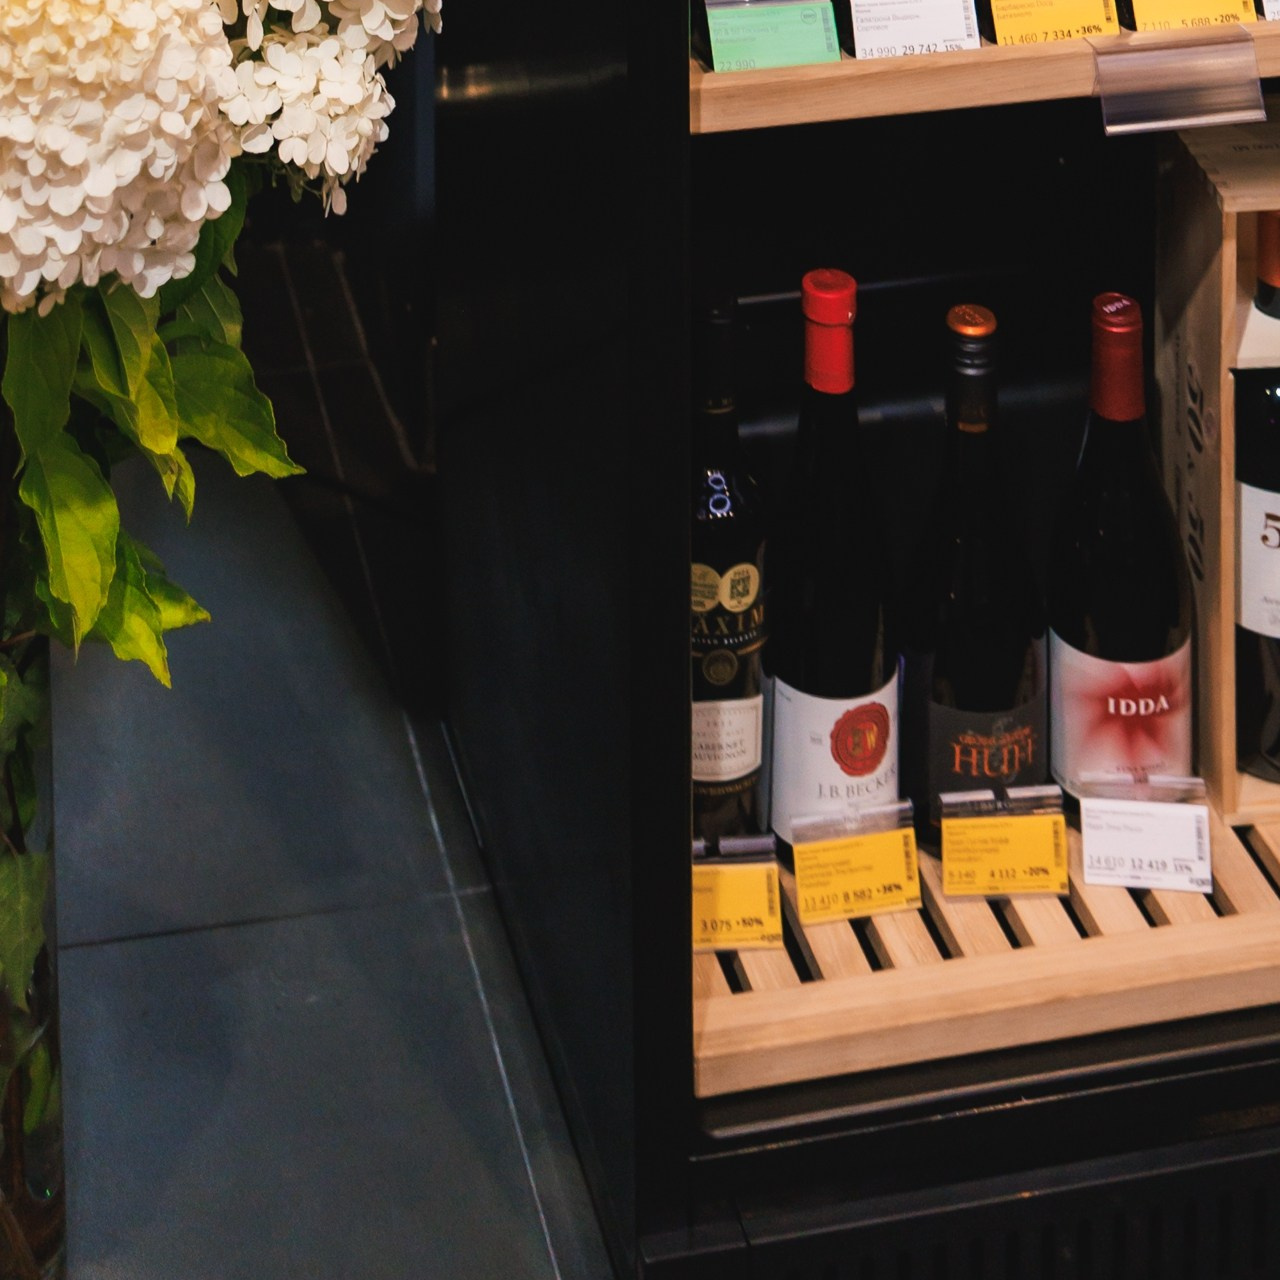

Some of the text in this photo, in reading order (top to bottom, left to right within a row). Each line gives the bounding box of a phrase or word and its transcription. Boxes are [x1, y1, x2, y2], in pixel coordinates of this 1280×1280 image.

[1220, 13, 1241, 23] 20%
[1019, 33, 1038, 44] 460
[1042, 31, 1049, 42] 7
[1052, 29, 1072, 40] 334
[1081, 24, 1103, 35] 36%
[902, 44, 915, 55] 29
[918, 43, 938, 54] 742
[1107, 695, 1170, 716] IDDA
